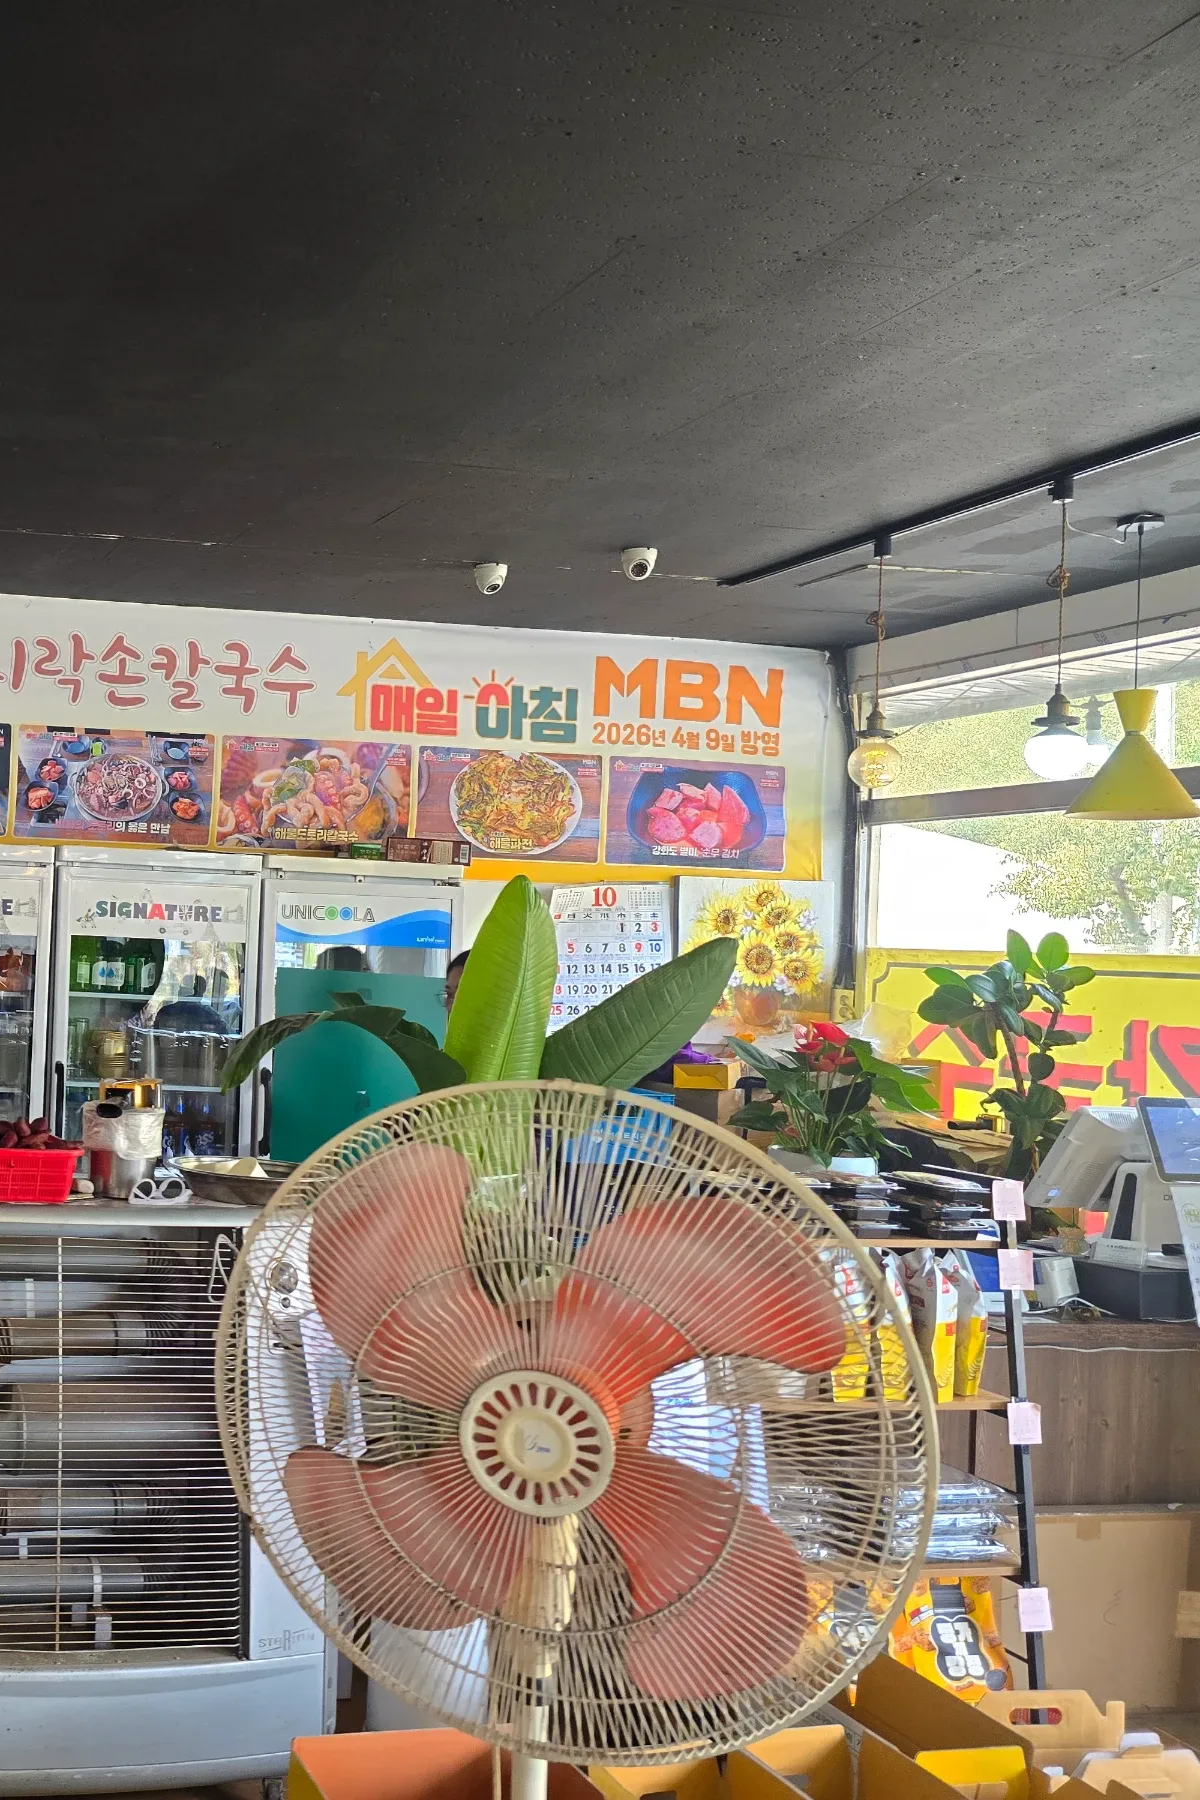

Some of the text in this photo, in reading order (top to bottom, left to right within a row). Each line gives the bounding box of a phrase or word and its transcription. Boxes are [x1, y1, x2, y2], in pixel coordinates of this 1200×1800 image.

[593, 655, 785, 728] MBN
[370, 683, 579, 743] 매일 아침
[592, 721, 781, 757] 2026년 4월 9일 방영
[150, 823, 171, 835] 만남
[490, 836, 533, 850] 해물파전
[652, 845, 678, 856] 강화도
[592, 887, 616, 906] 10
[96, 900, 222, 922] SIGNATURE
[281, 904, 375, 922] UNICOOLA
[635, 923, 641, 932] 2
[651, 922, 658, 932] 3
[567, 942, 660, 953] 5 6 7 8 9 10
[567, 964, 578, 974] 12
[584, 964, 594, 974] 13
[601, 964, 612, 974] 14
[618, 964, 629, 973] 15
[634, 963, 645, 973] 16
[568, 985, 578, 995] 19
[584, 985, 597, 994] 20
[602, 985, 612, 994] 21
[551, 1006, 562, 1015] 25
[567, 1006, 579, 1015] 26
